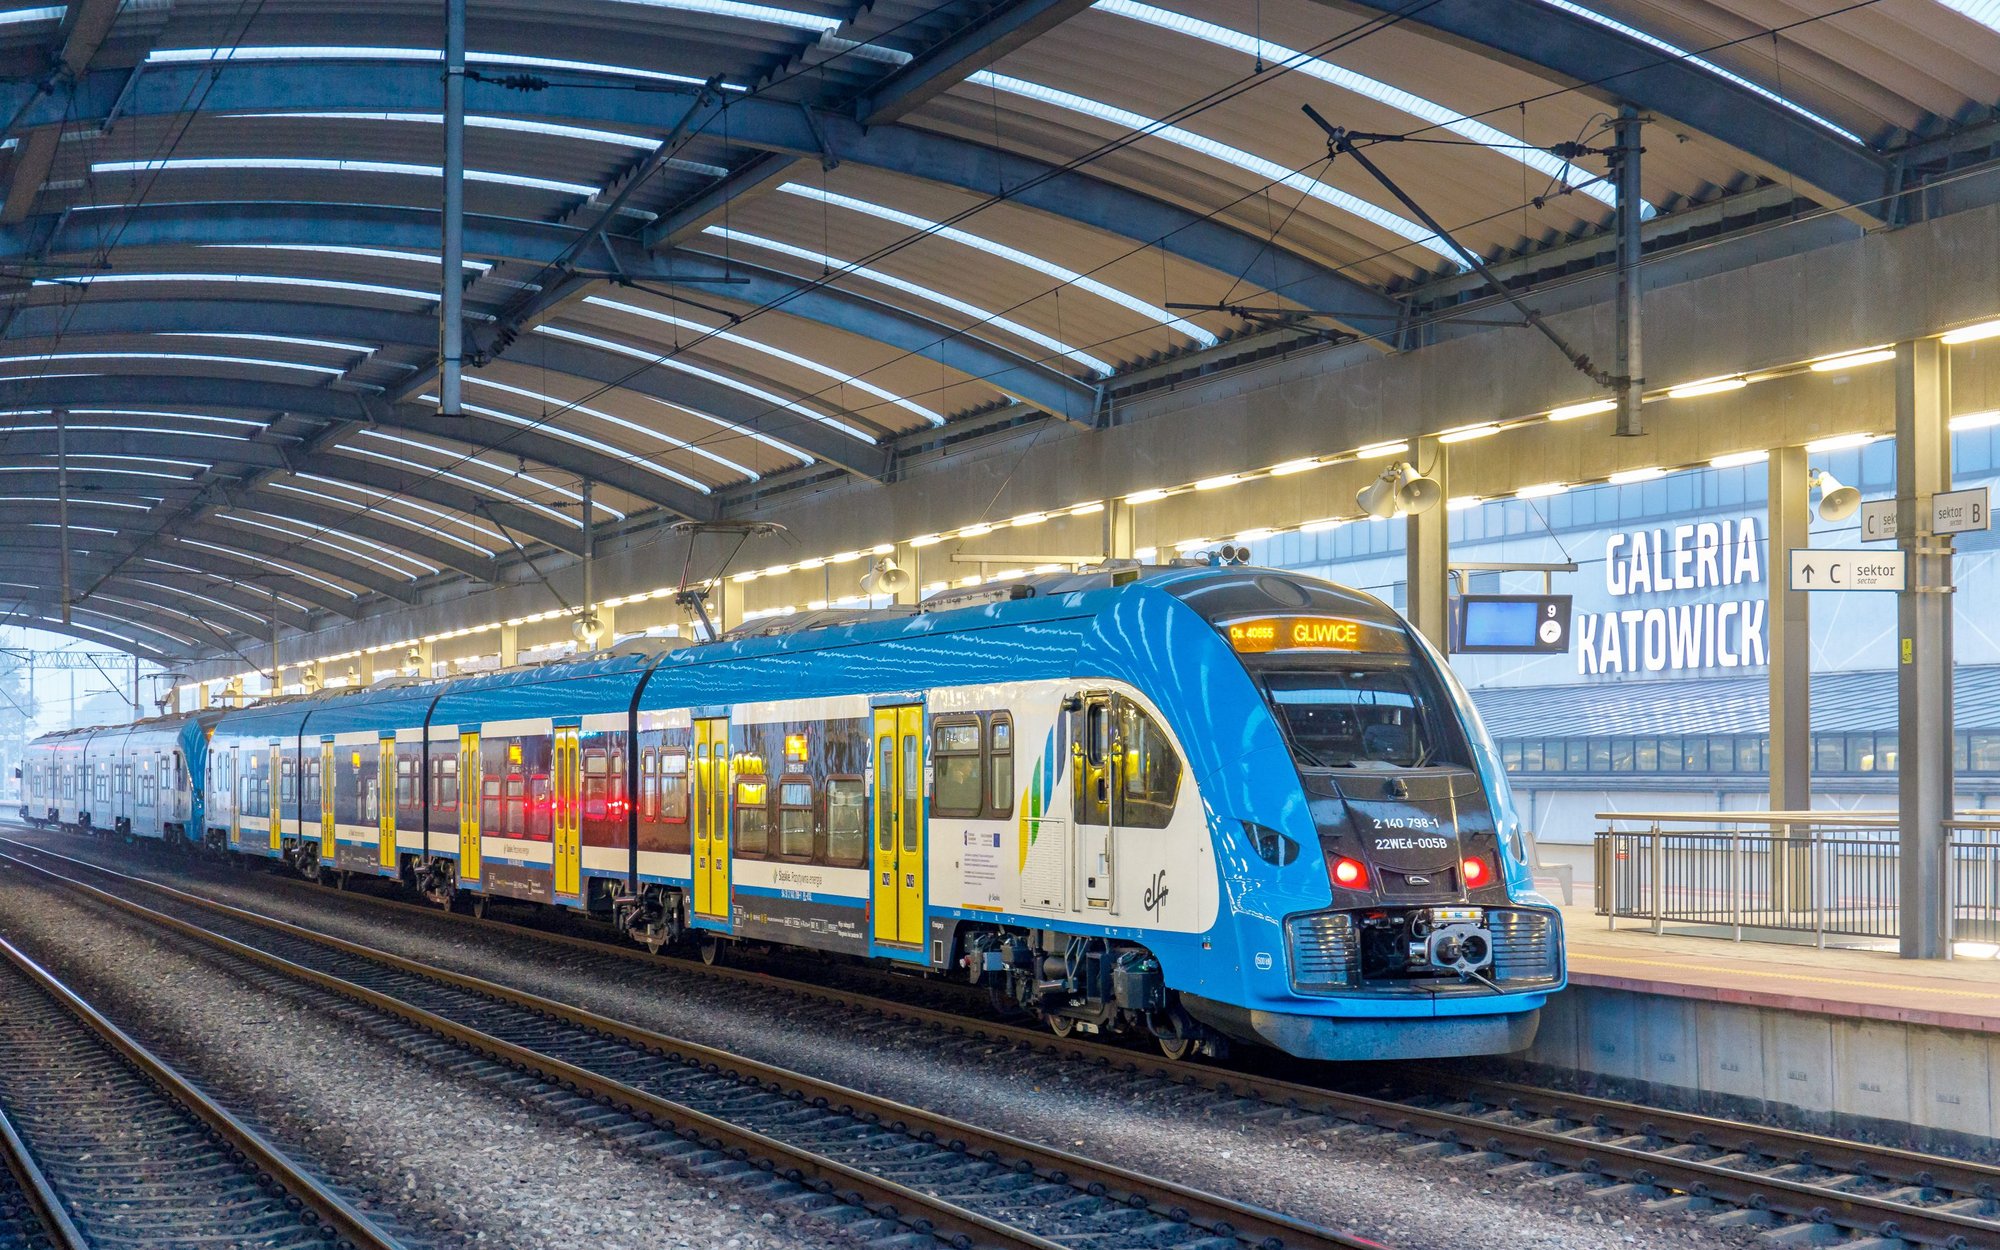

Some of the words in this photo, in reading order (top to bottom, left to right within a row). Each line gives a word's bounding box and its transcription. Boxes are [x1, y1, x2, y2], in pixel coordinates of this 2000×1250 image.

[1938, 506, 1963, 519] sektor
[1972, 503, 1981, 523] B
[1868, 514, 1875, 535] C
[1606, 517, 1760, 596] GALERIA
[1829, 563, 1841, 584] C
[1856, 564, 1896, 576] sektor
[1856, 577, 1878, 585] sector
[1547, 604, 1557, 618] 9
[1293, 624, 1357, 643] GLIWICE
[1577, 599, 1770, 675] KATOWICK
[866, 738, 872, 767] 2
[925, 735, 932, 765] 2
[1373, 818, 1382, 829] 2
[1384, 818, 1404, 829] 140
[1406, 818, 1440, 829] 798-1
[1375, 838, 1448, 850] 22WEd-005B
